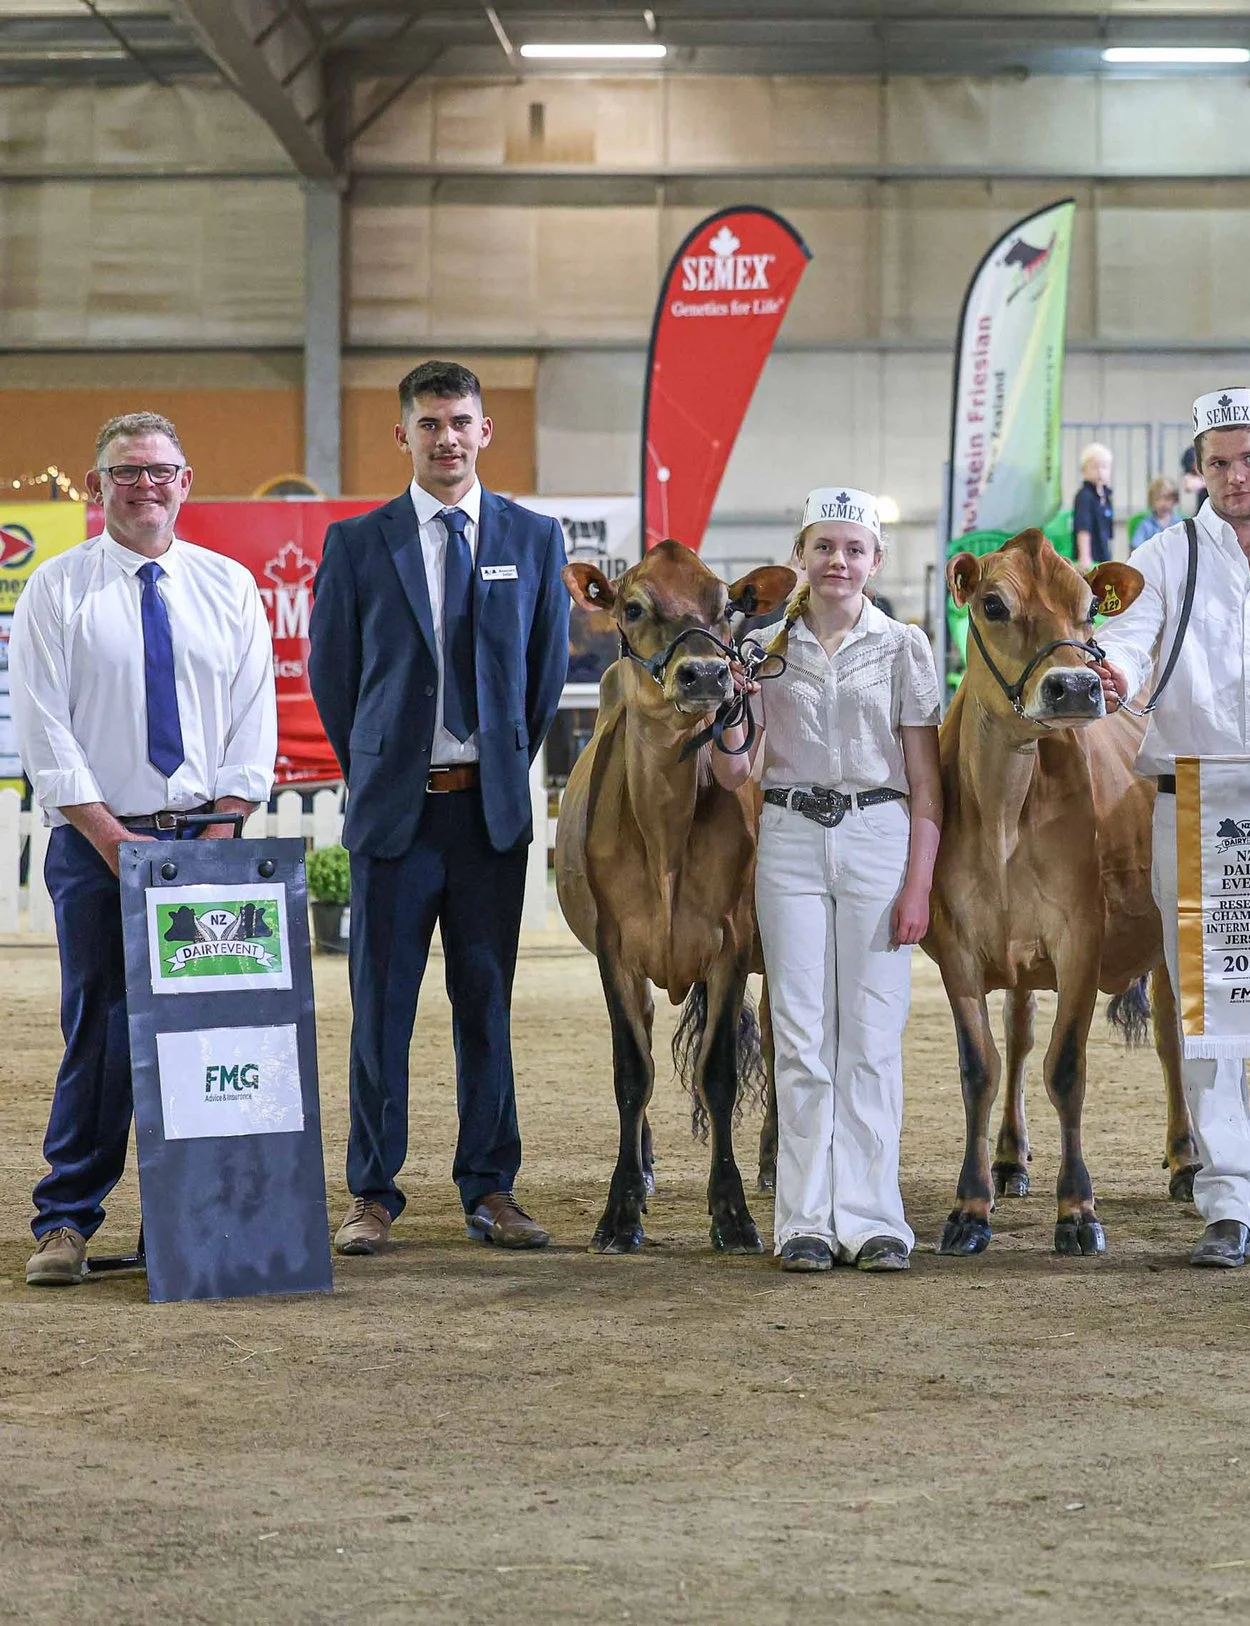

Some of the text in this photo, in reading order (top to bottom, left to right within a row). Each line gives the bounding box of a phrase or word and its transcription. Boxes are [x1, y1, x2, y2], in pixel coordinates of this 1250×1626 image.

[671, 301, 730, 317] Genetics
[730, 298, 750, 315] for
[966, 316, 993, 423] Friesian
[1206, 405, 1250, 426] SEMEX
[820, 503, 865, 522] SEMEX
[210, 912, 228, 926] NZ
[182, 943, 259, 960] DAIRYEVENT
[205, 1063, 259, 1093] FMG
[222, 1094, 227, 1102] &
